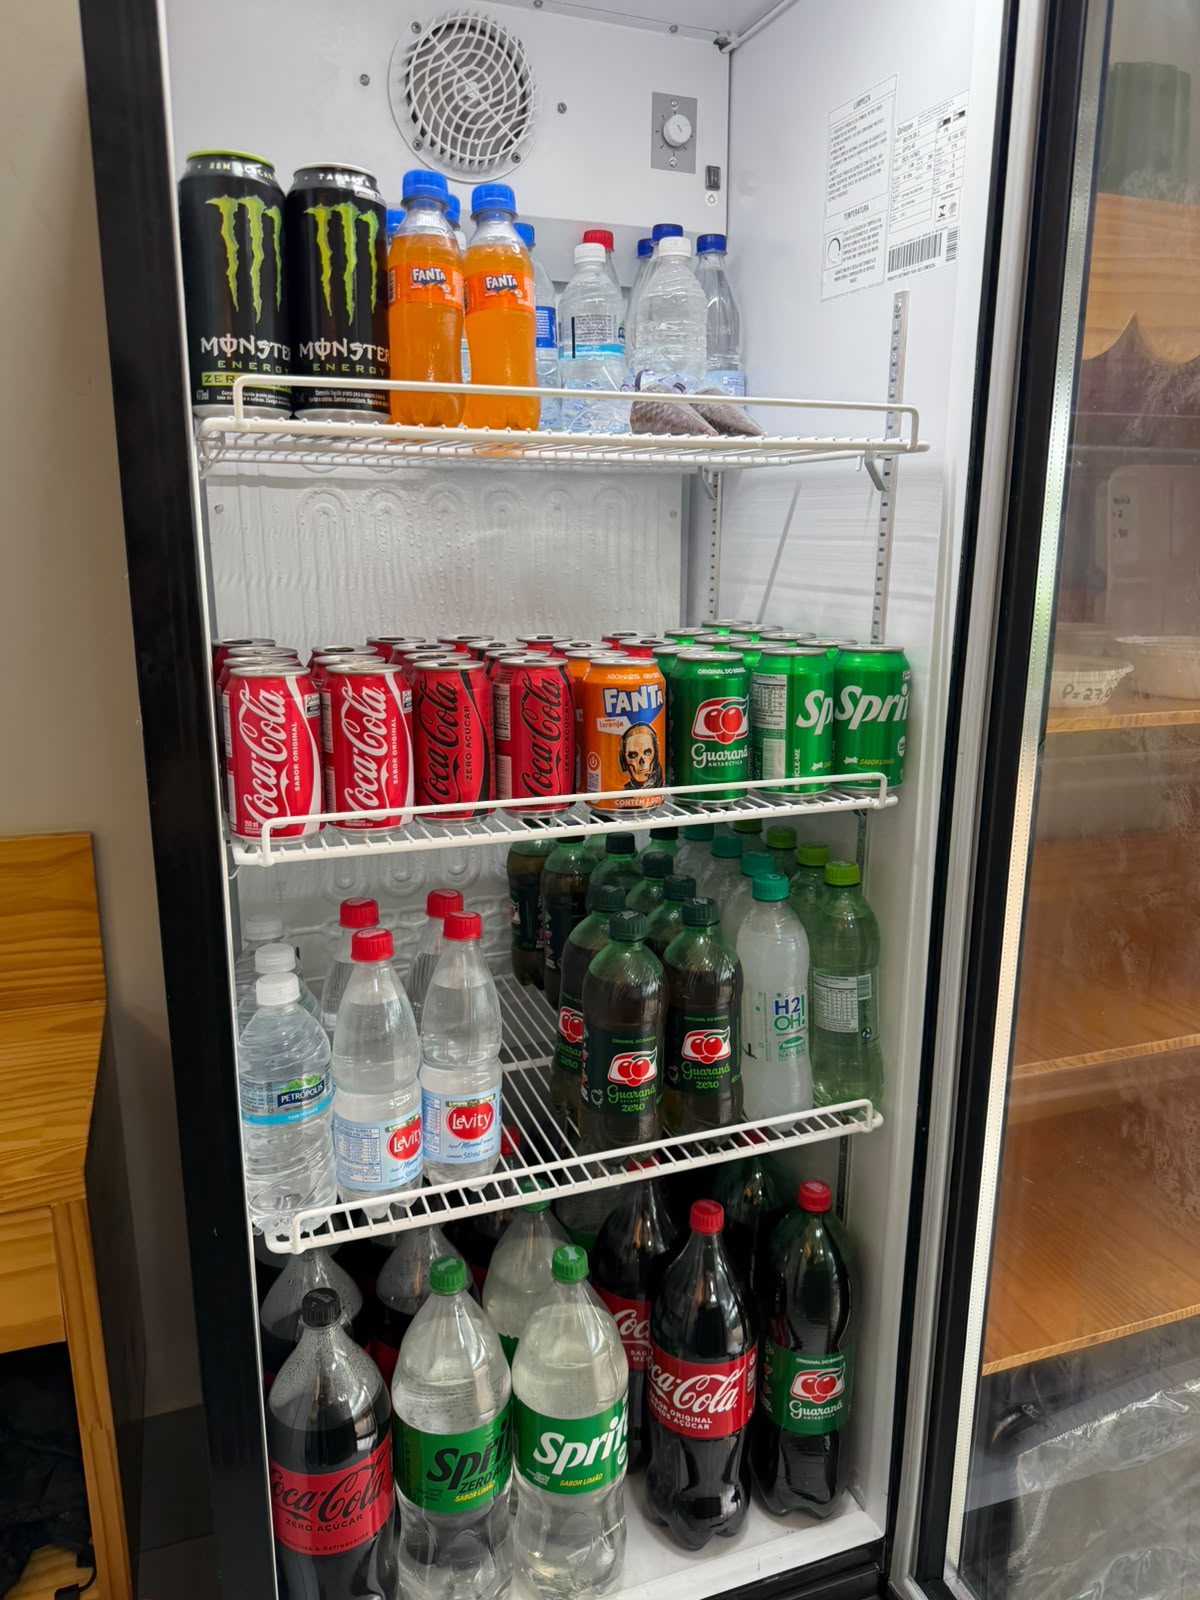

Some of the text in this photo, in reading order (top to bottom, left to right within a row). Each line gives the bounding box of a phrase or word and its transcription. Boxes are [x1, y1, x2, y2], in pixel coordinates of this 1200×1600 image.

[209, 162, 231, 170] SEM
[412, 267, 446, 281] FANTA
[485, 274, 517, 289] FANTA
[200, 333, 291, 361] MONSTE
[217, 360, 289, 375] ENERGY
[312, 363, 385, 376] ENERGY
[203, 374, 240, 384] ZER
[604, 684, 663, 714] FANTA
[418, 672, 460, 805] Coca-Cola
[521, 671, 562, 797] Coca-Cola
[239, 680, 288, 829] Coca-Cola
[341, 677, 388, 821] Coca-Cola
[691, 743, 749, 769] Guaraná
[464, 753, 472, 781] ZERO
[708, 759, 743, 767] ANTARCTICA
[681, 1061, 731, 1080] Guaraná
[281, 1083, 324, 1103] PETRÓPOLIS
[607, 1084, 656, 1104] Guaraná
[696, 1080, 720, 1089] zero
[621, 1103, 646, 1113] zero
[452, 1111, 492, 1130] Levity
[669, 1409, 713, 1424] ORIGINAL
[788, 1399, 843, 1419] Guaraná
[673, 1418, 710, 1430] AÇÚCAR
[459, 1472, 492, 1494] ZERO
[559, 1479, 584, 1487] SABOR
[454, 1491, 478, 1502] SABOR
[286, 1513, 364, 1533] ZERO AÇÚCAR
